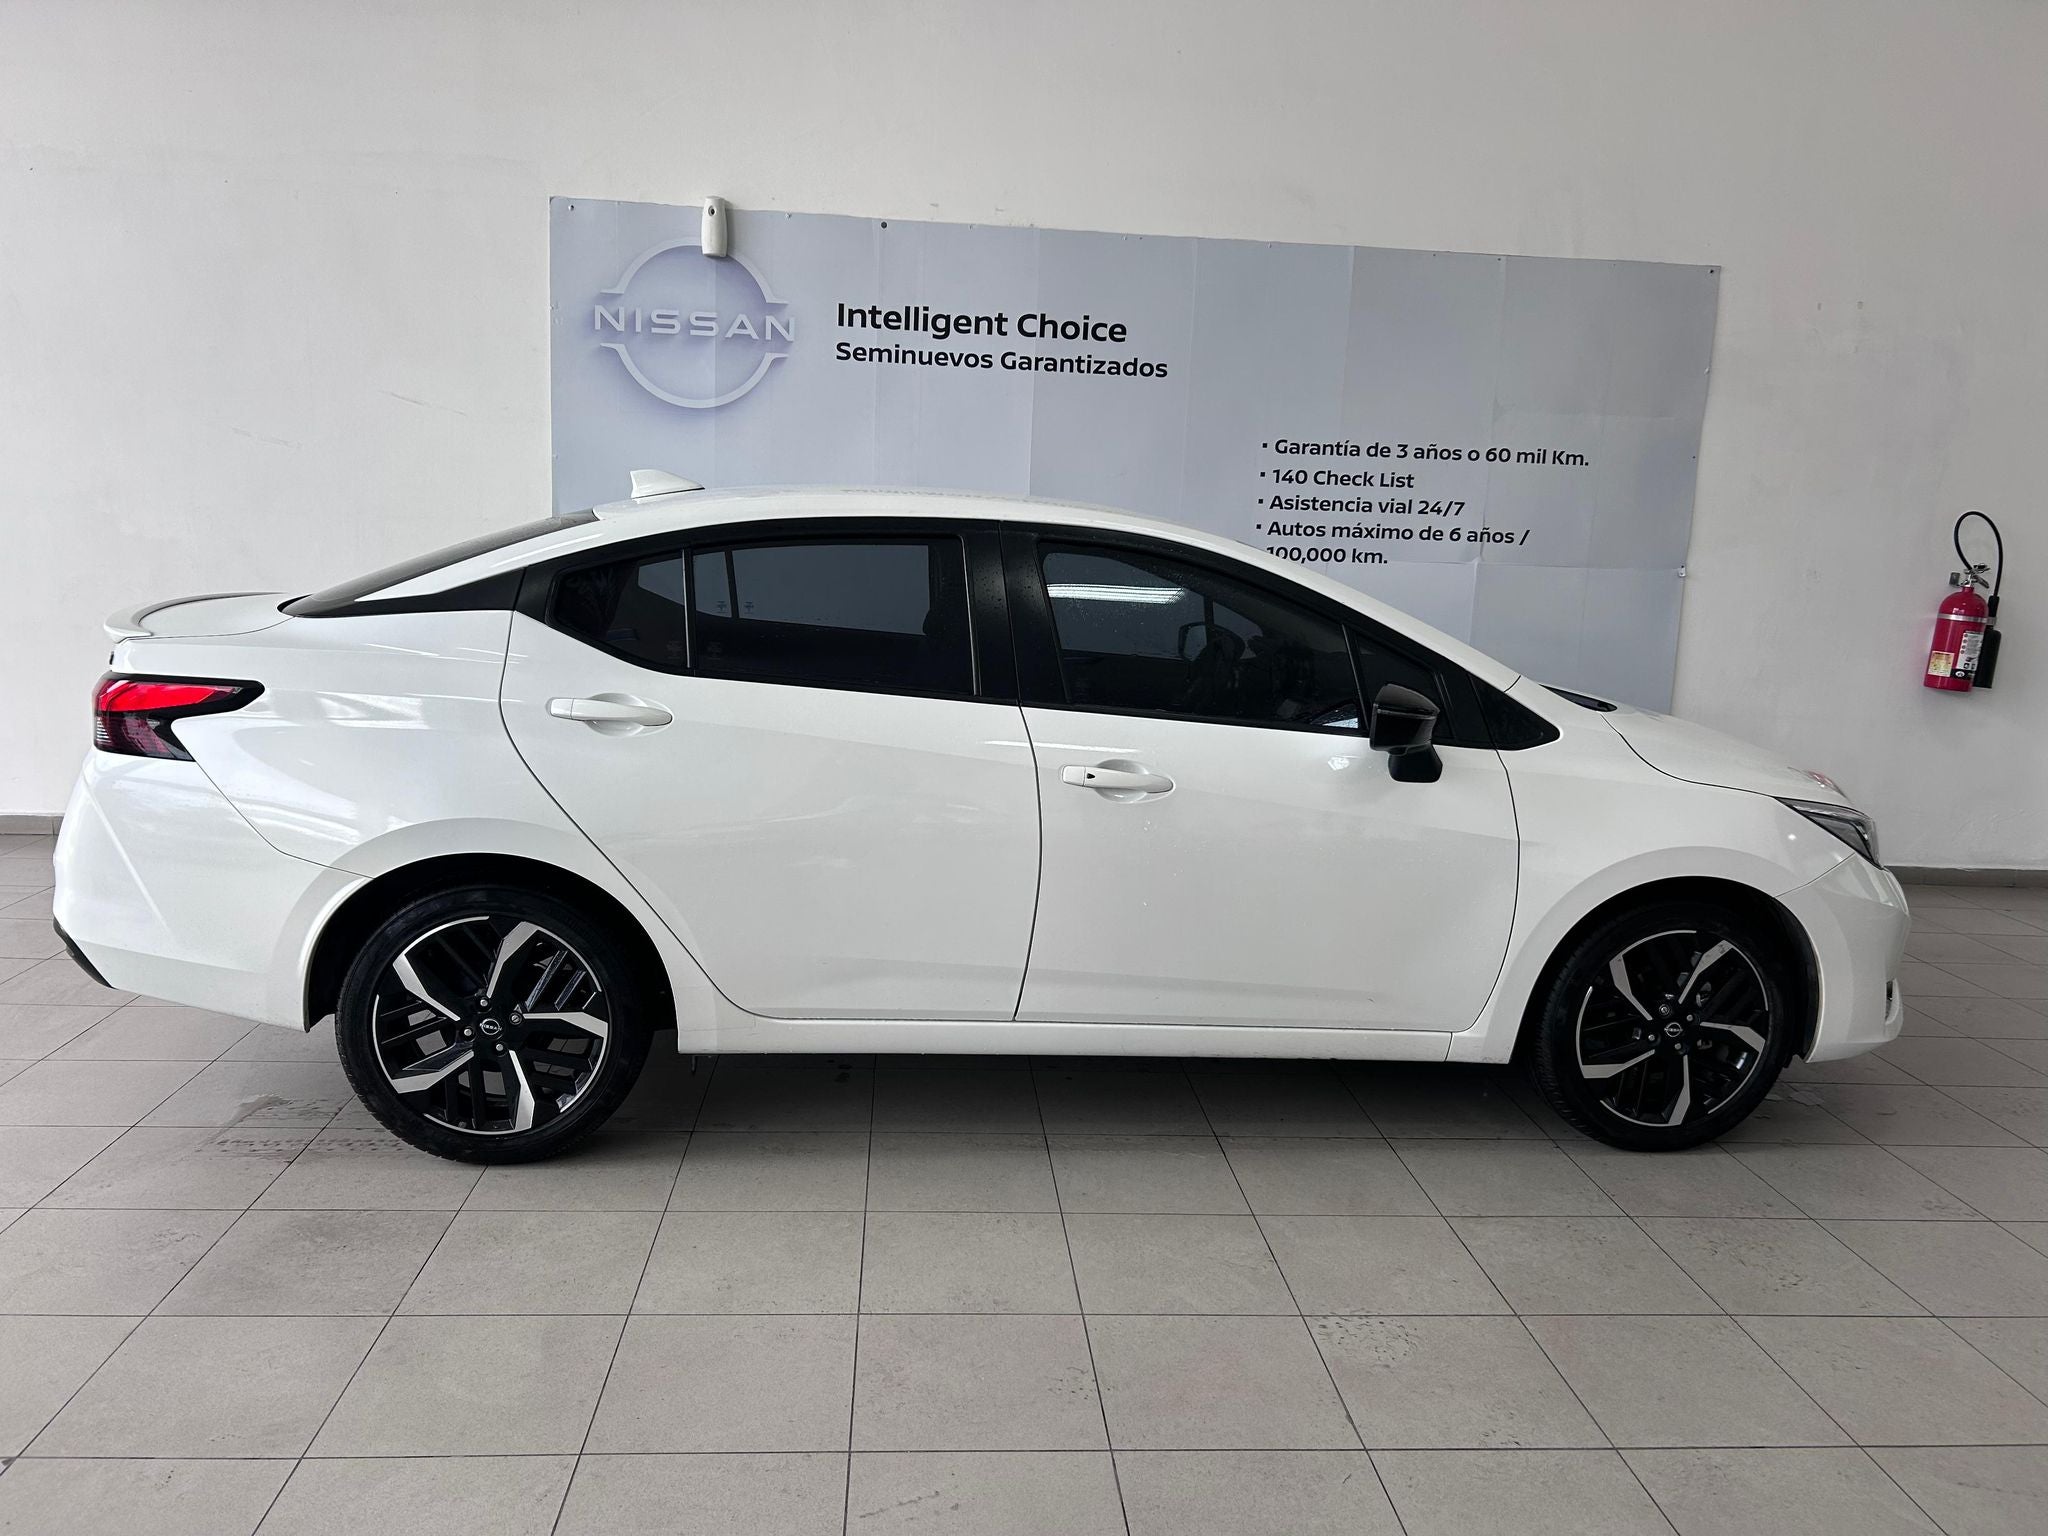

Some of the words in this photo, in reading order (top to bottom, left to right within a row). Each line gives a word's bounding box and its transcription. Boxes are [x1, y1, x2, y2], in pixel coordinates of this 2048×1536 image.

[594, 304, 795, 342] NISSAN
[837, 303, 1009, 340] Intelligent
[1017, 313, 1127, 343] Choice
[836, 341, 994, 369] Seminuevos
[1000, 352, 1168, 378] Garantizados
[1274, 439, 1361, 457] Garantía
[1366, 441, 1392, 458] de
[1396, 443, 1409, 459] 3
[1413, 443, 1463, 461] años
[1467, 449, 1481, 462] o
[1485, 447, 1512, 463] 60
[1516, 448, 1547, 465] mil
[1551, 450, 1589, 467] Km.
[1272, 468, 1308, 485] 140
[1313, 469, 1375, 487] Check
[1379, 471, 1415, 489] List
[1269, 494, 1373, 513] Asistencia
[1377, 497, 1413, 515] vial
[1417, 500, 1466, 518] 24/7
[1266, 521, 1326, 538] Autos
[1331, 522, 1414, 541] máximo
[1418, 525, 1444, 542] de
[1449, 527, 1462, 542] 6
[1466, 526, 1515, 544] años
[1518, 529, 1531, 546] /
[1351, 547, 1388, 564] km.
